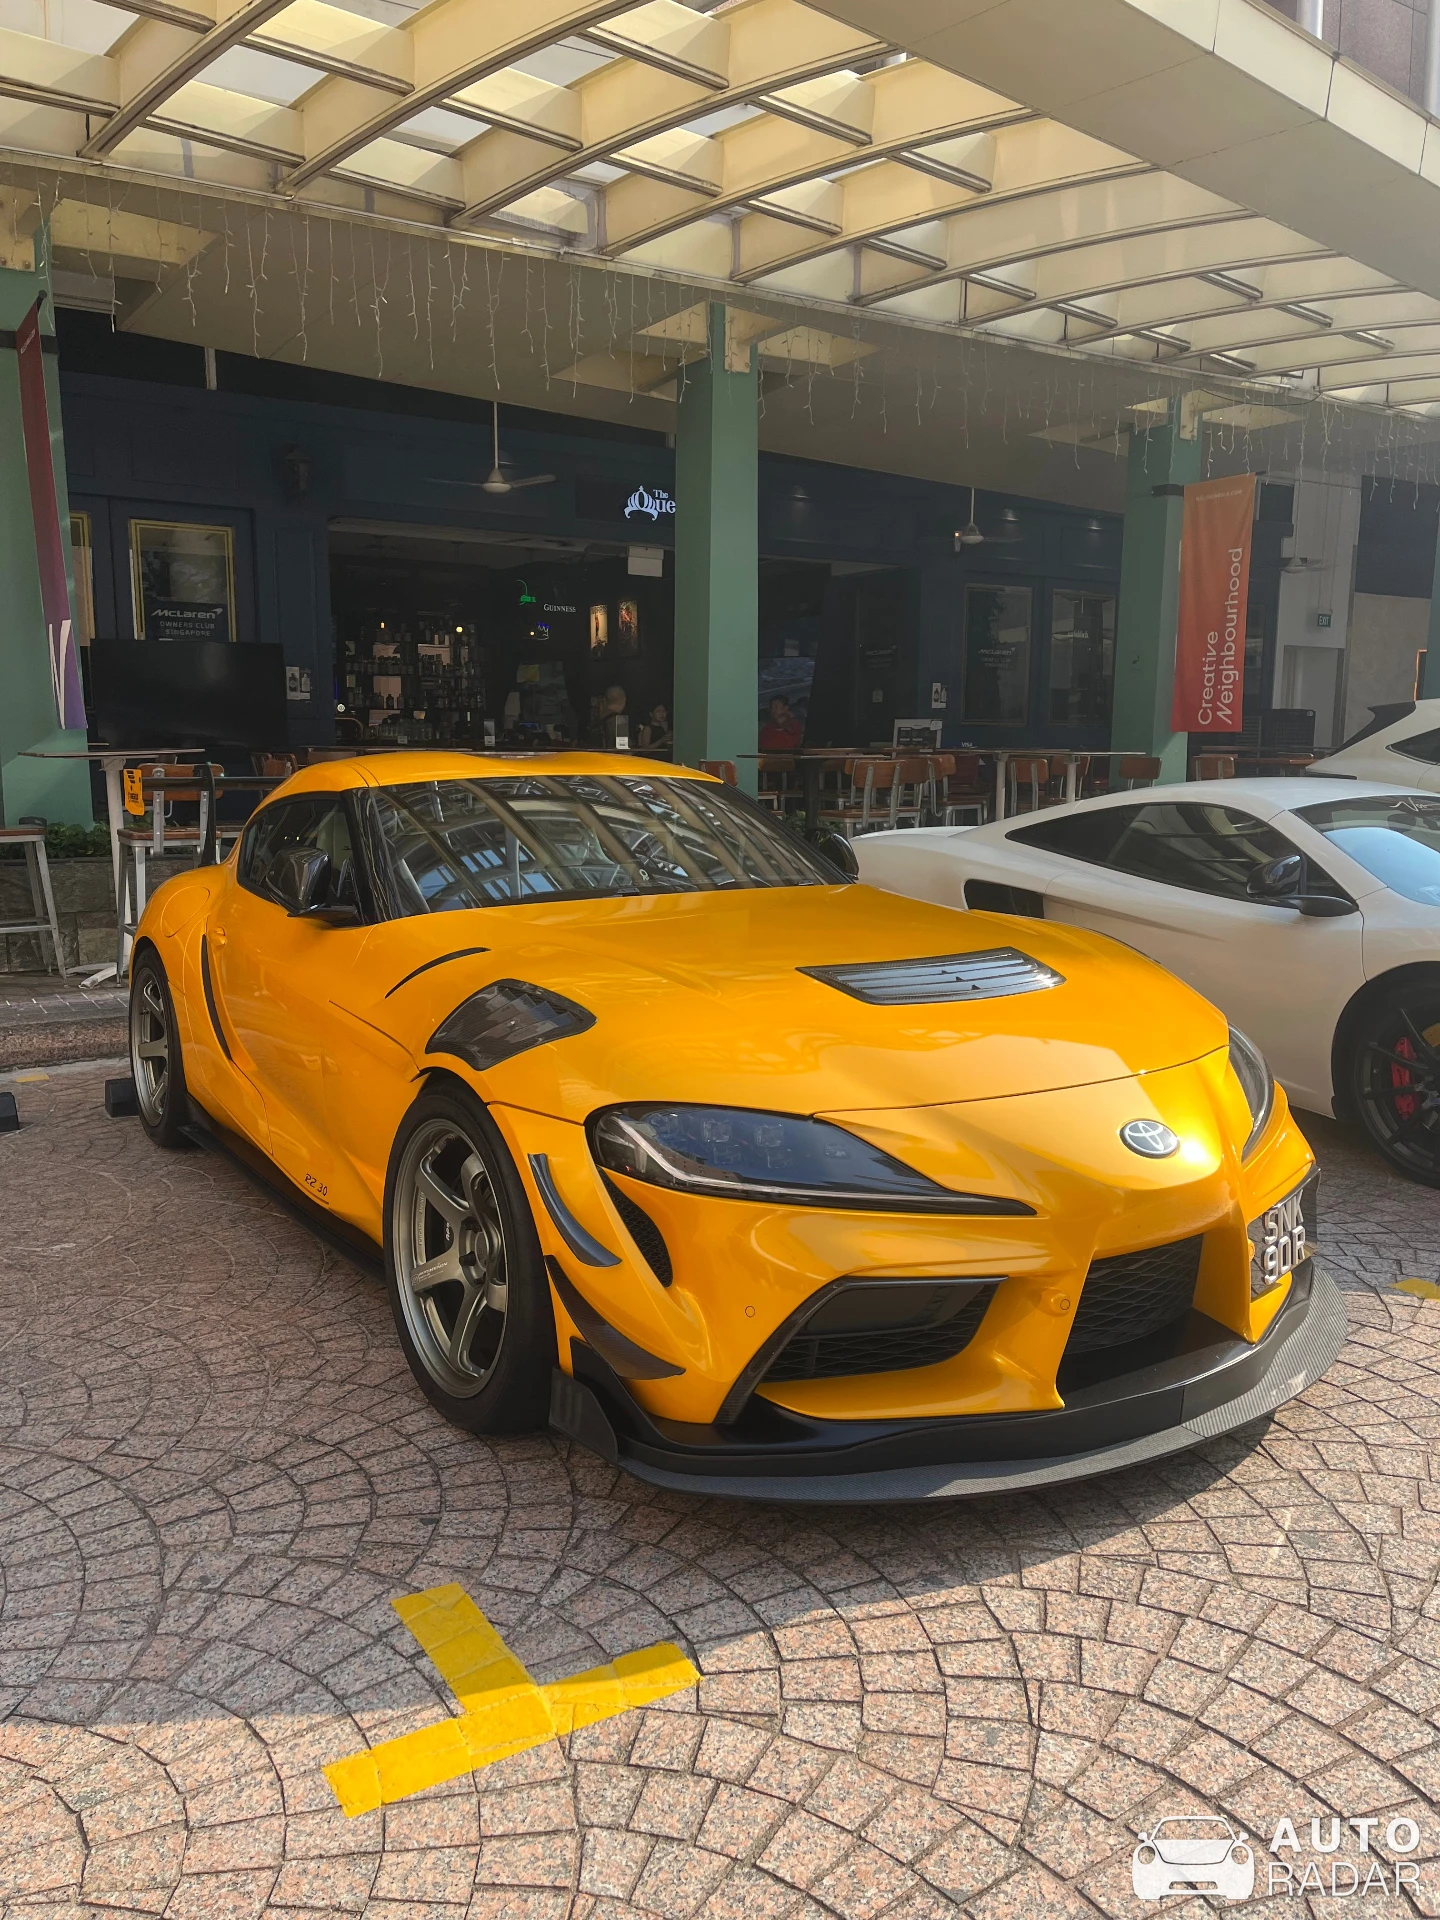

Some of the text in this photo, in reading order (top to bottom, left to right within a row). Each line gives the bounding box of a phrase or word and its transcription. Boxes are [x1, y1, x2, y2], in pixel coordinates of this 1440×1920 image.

[653, 489, 669, 499] The
[151, 608, 217, 620] McLaren
[1216, 547, 1243, 725] Neighbourhood
[1319, 616, 1330, 626] EXIT
[1197, 630, 1219, 725] Creative
[1263, 1188, 1304, 1245] SNK
[1264, 1225, 1306, 1285] 90R
